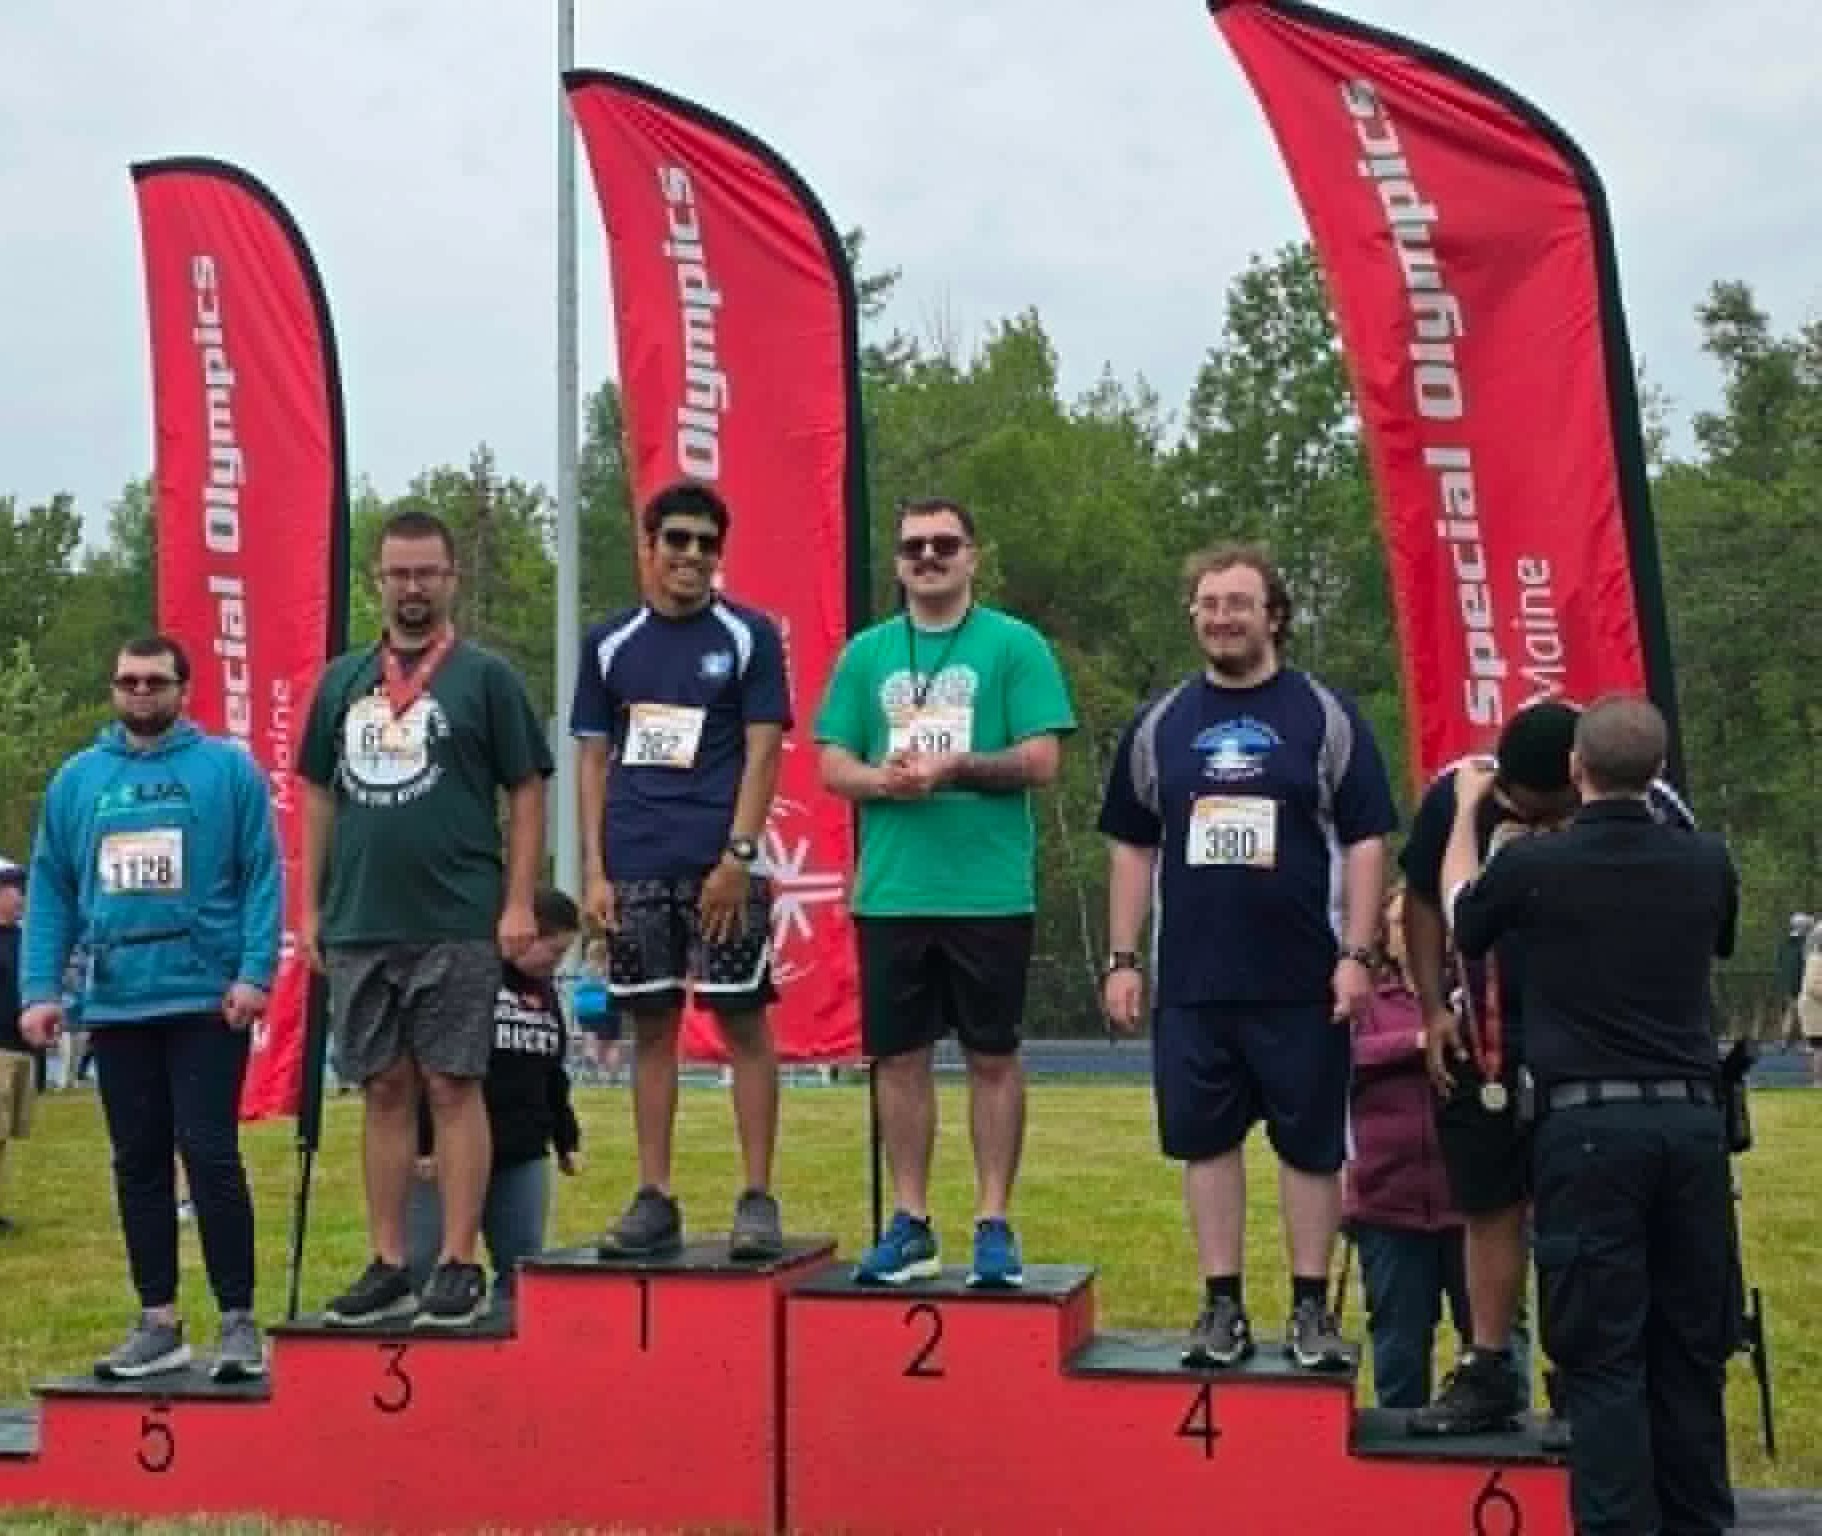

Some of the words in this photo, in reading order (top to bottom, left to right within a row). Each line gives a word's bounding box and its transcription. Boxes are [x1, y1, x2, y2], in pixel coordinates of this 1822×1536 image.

[1340, 79, 1466, 417] Olympics
[657, 166, 730, 481] Olympics
[193, 256, 245, 553] Olympics
[1422, 447, 1508, 726] Special
[209, 576, 251, 745] ecial
[111, 858, 174, 889] 1128
[1206, 825, 1257, 859] 380
[635, 1279, 651, 1350] 1
[903, 1303, 945, 1377] 2
[374, 1344, 413, 1412] 3
[137, 1406, 175, 1472] 5
[1176, 1383, 1222, 1458] 4
[1473, 1471, 1523, 1536] 6
